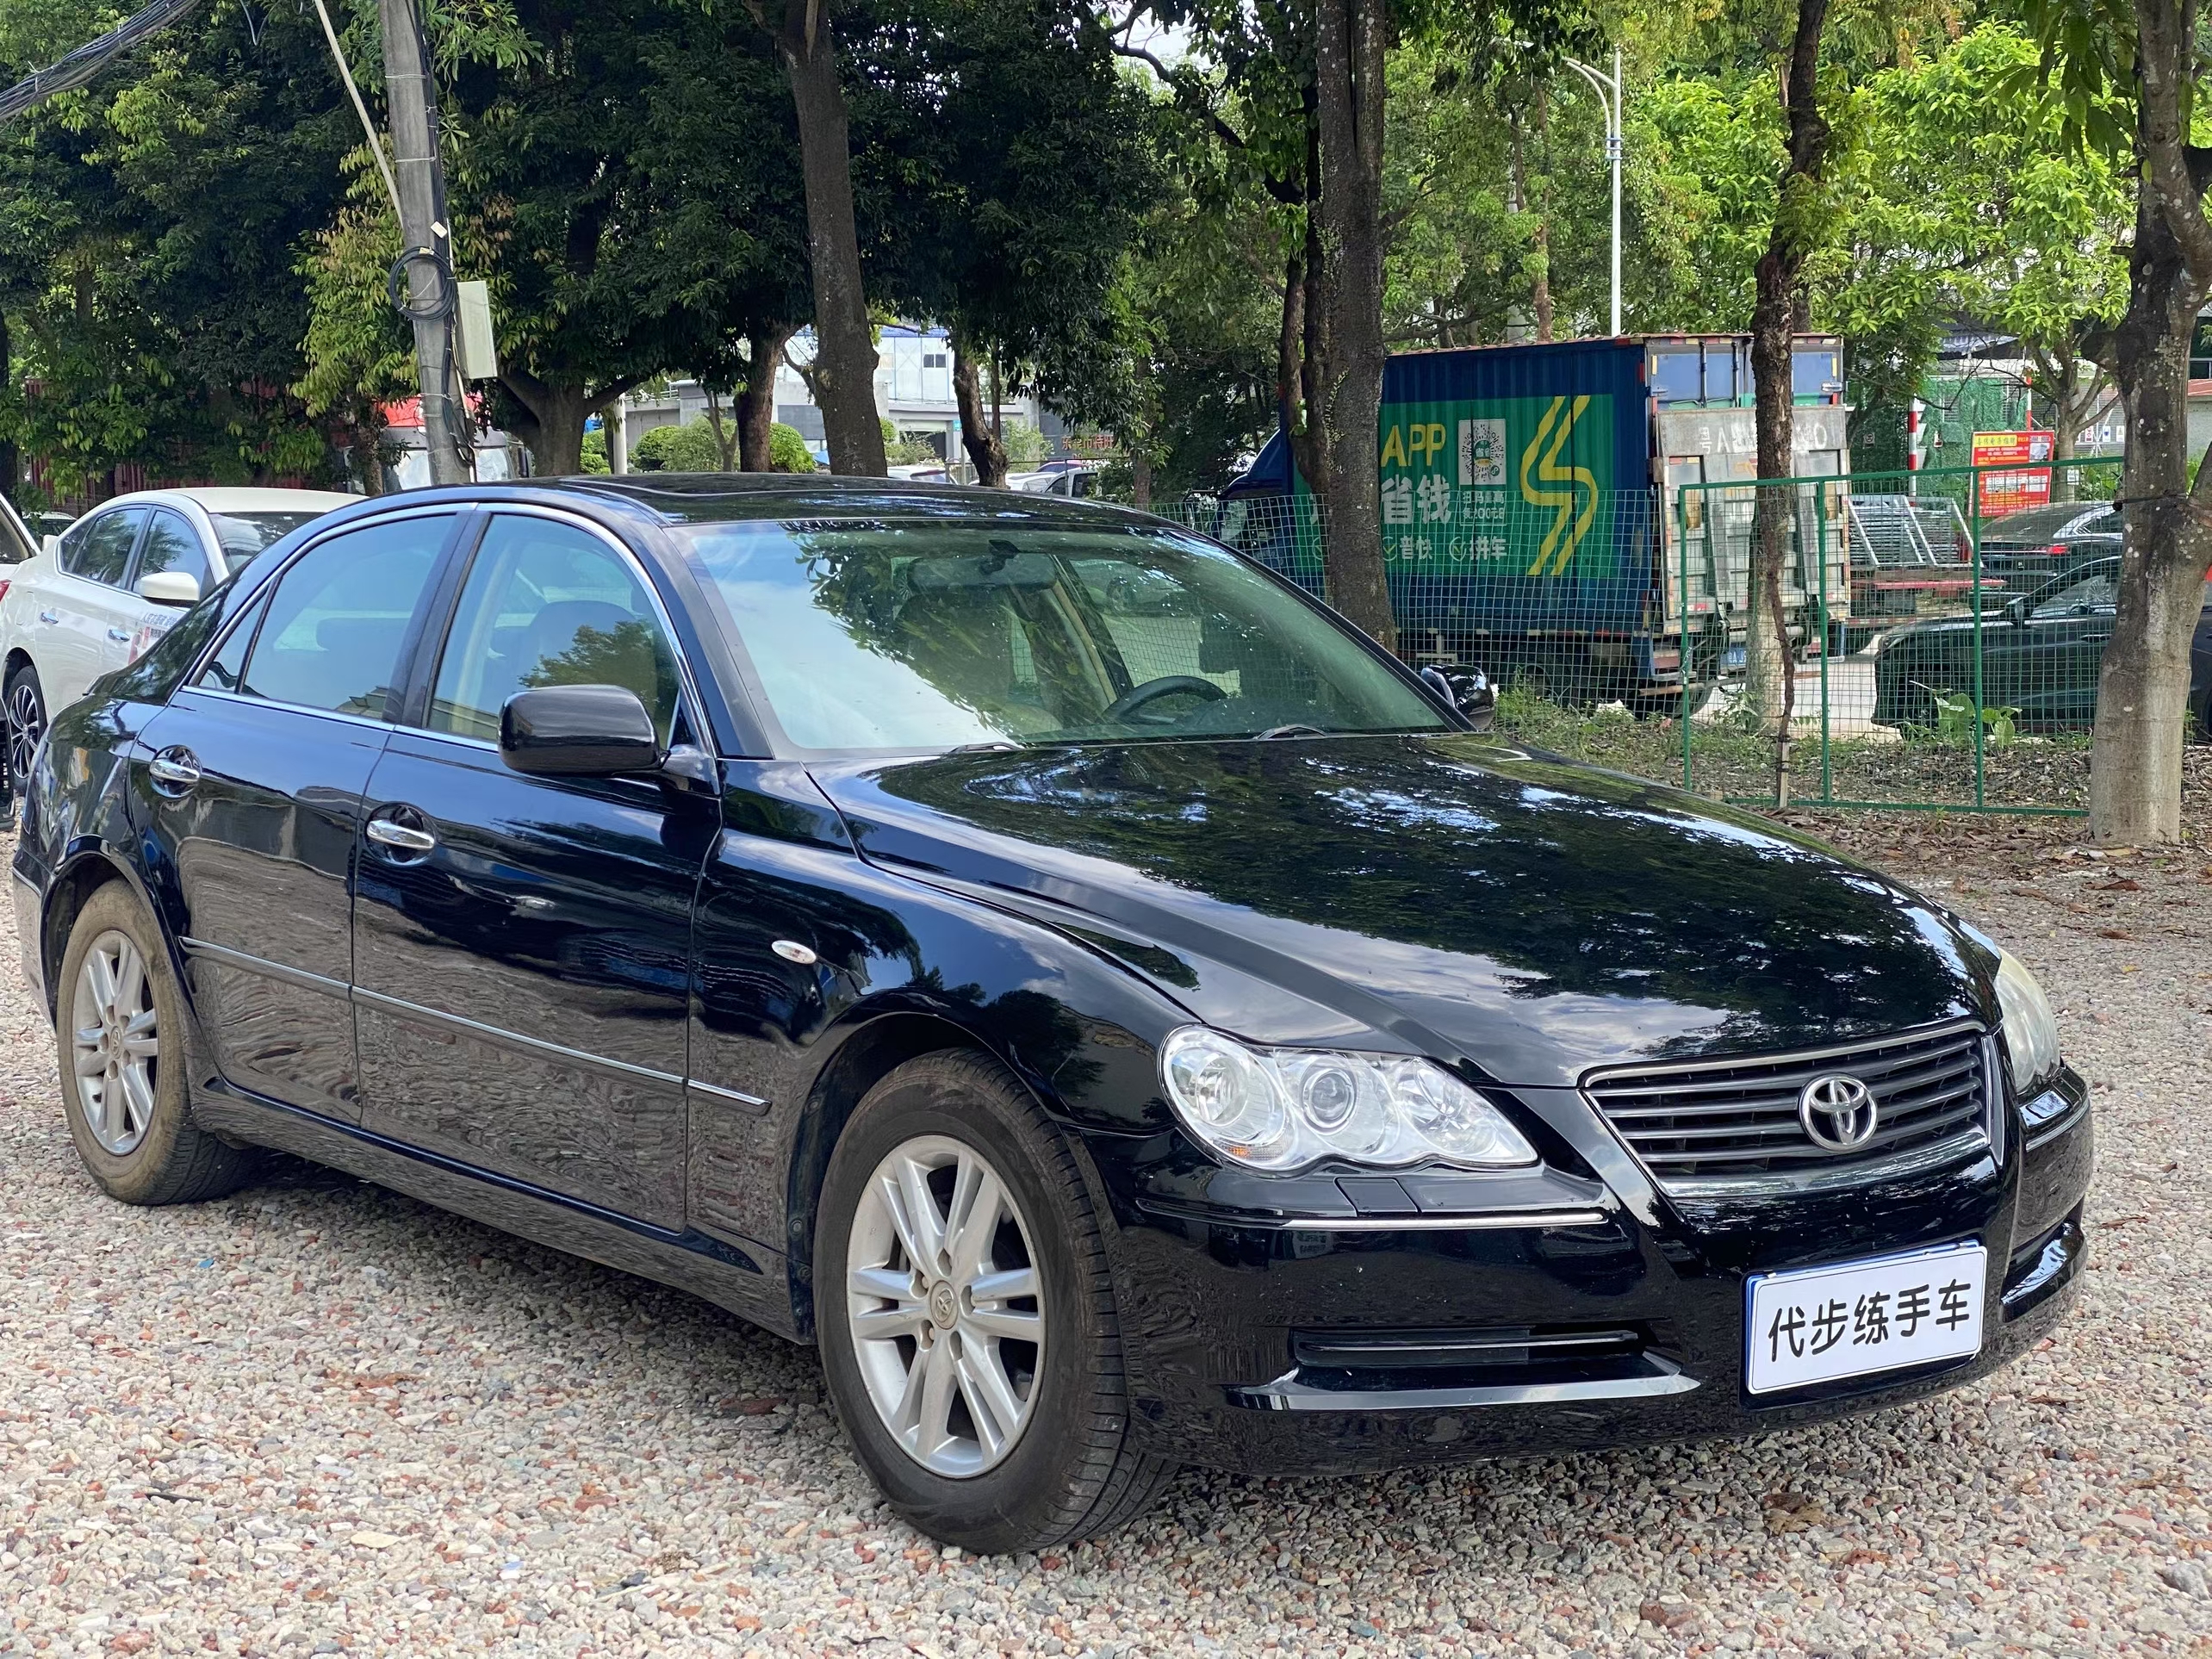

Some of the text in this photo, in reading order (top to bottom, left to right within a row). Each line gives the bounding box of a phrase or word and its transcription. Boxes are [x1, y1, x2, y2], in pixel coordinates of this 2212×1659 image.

[1381, 423, 1446, 467] APP
[1381, 474, 1451, 525] 省钱
[1400, 535, 1507, 561] 普快 拼车
[1768, 1278, 1972, 1363] 代步练手车
